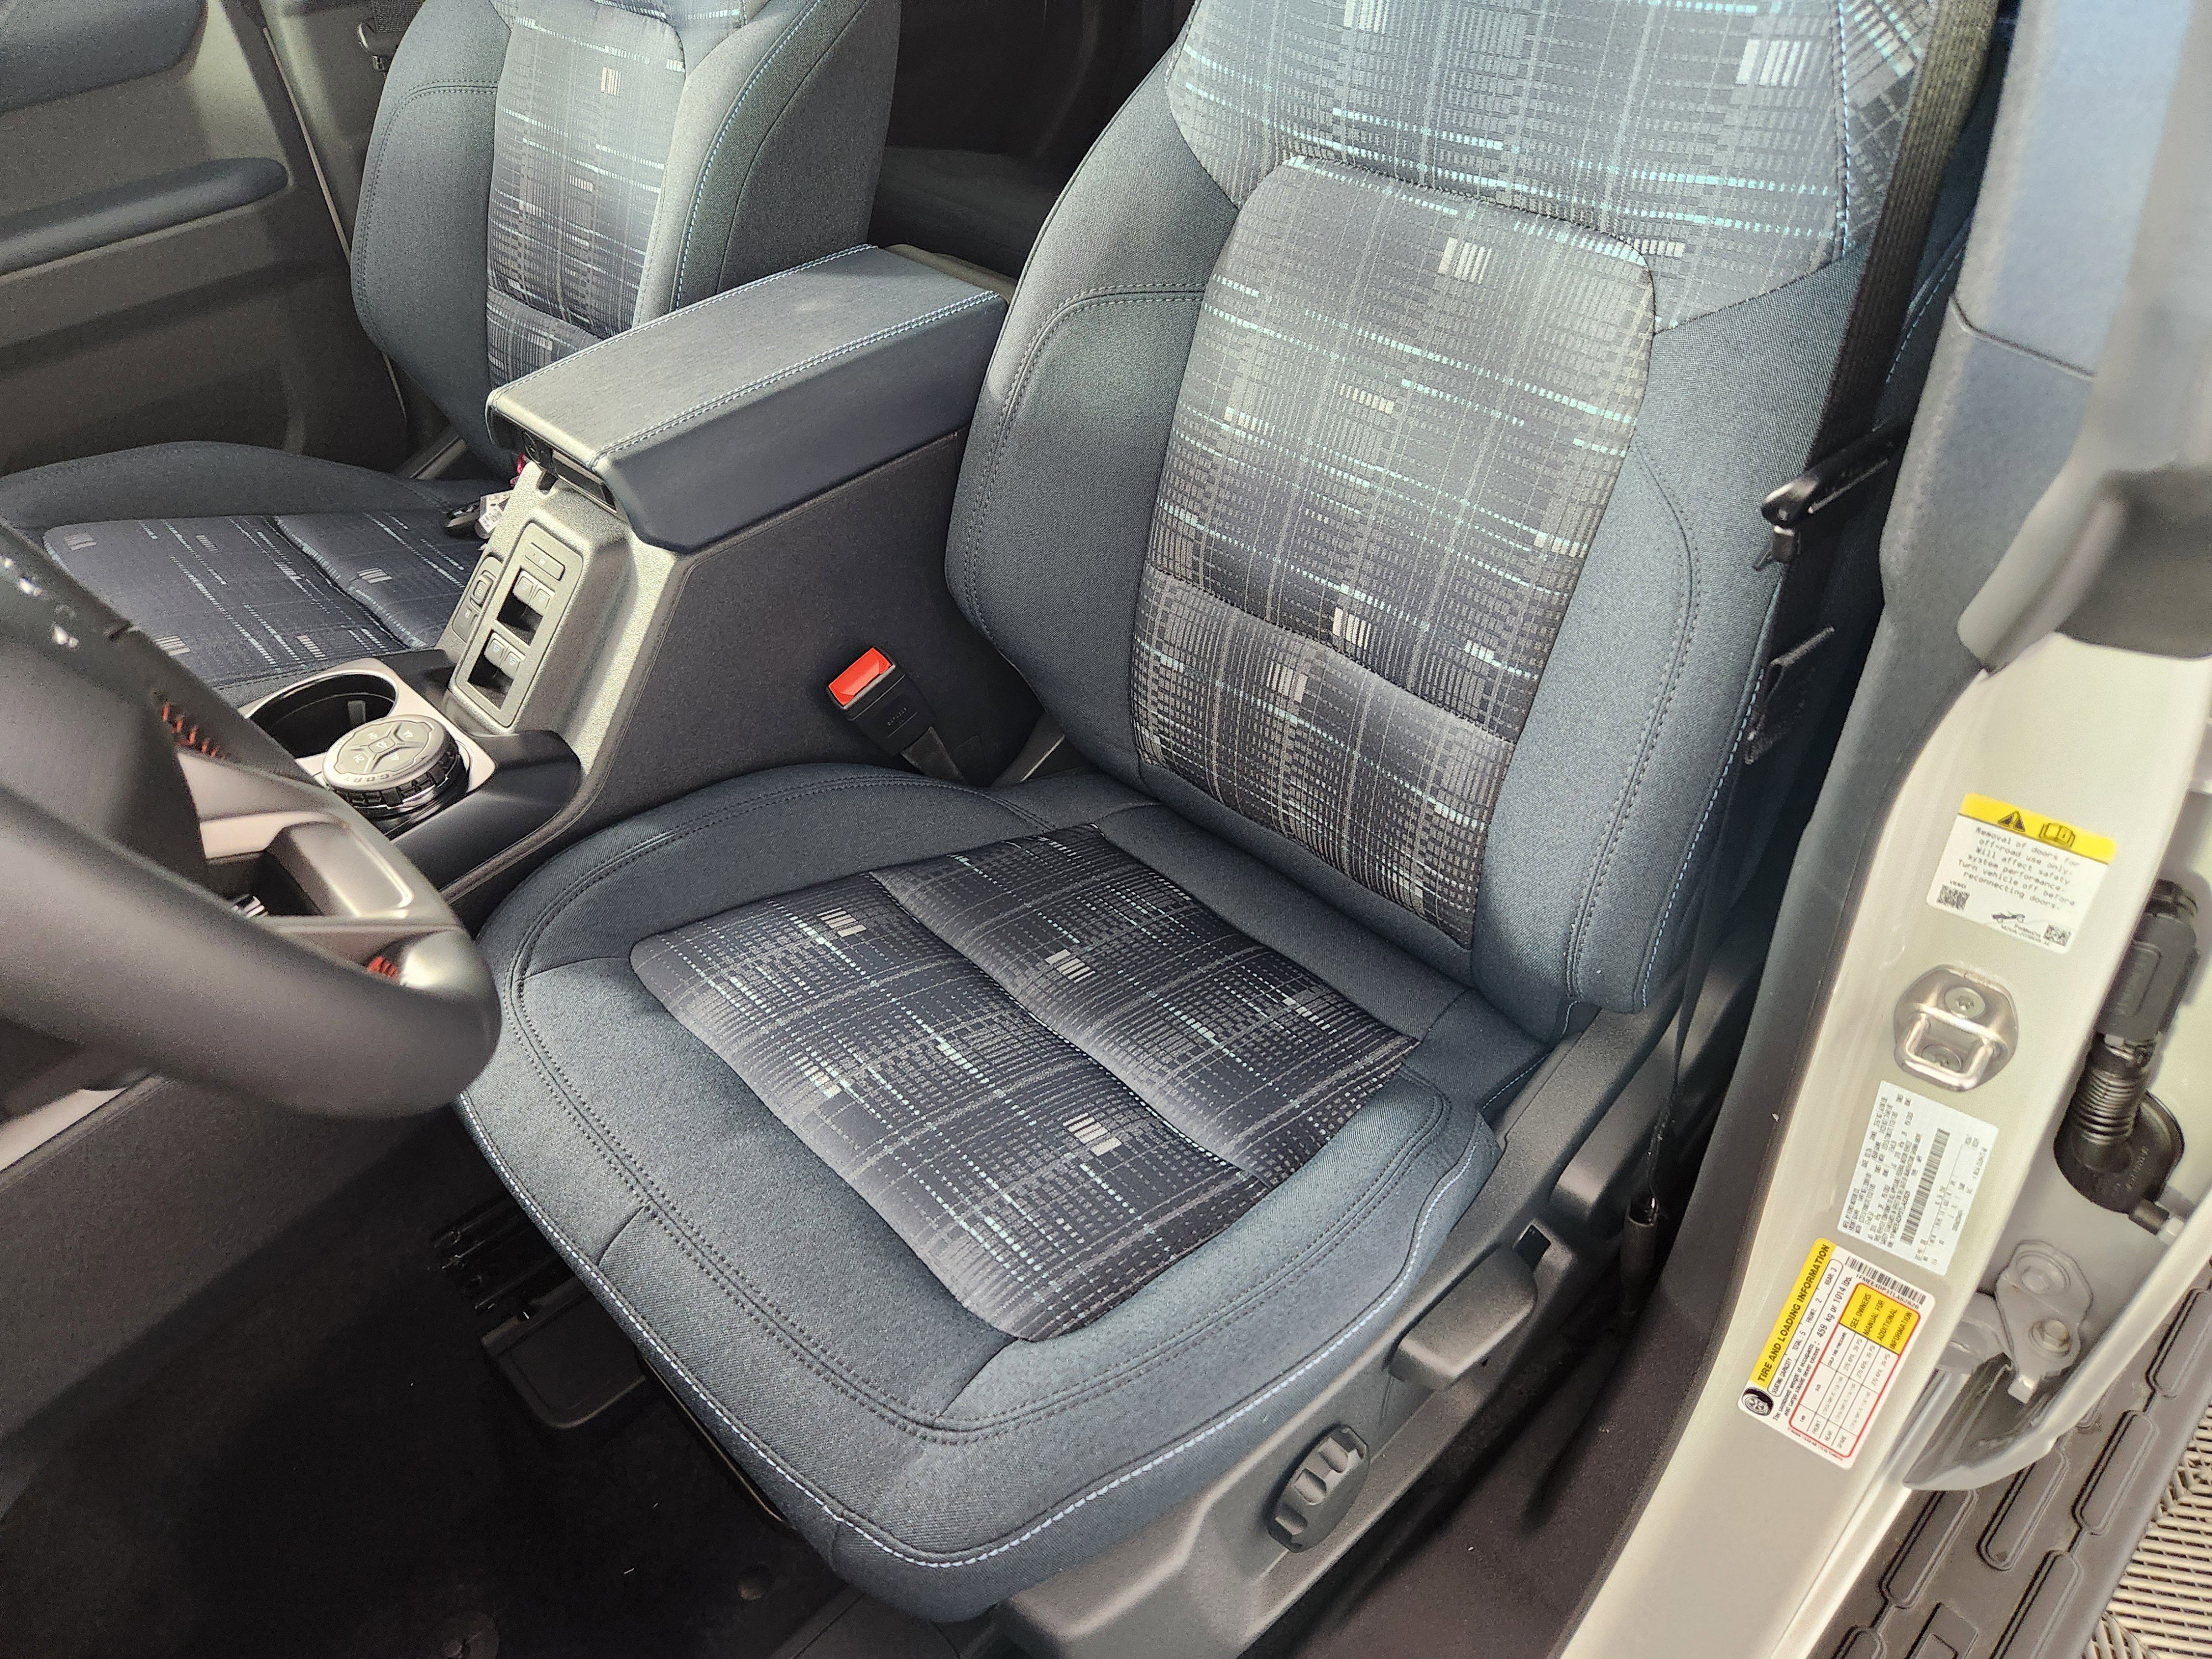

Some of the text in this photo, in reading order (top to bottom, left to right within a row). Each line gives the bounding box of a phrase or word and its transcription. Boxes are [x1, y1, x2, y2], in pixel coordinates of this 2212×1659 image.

[1975, 826, 2011, 844] Removal
[2031, 847, 2058, 860] doors
[2064, 857, 2080, 867] for
[1979, 839, 2072, 875] off-road use only.
[1959, 859, 1978, 872] Turn
[1983, 869, 2018, 886] vehicle
[2022, 883, 2038, 892] off
[2043, 890, 2075, 906] before
[1968, 854, 2063, 891] system performance.
[1975, 846, 2070, 885] Will affect safety
[1963, 872, 2025, 899] reconnecting
[2030, 895, 2059, 909] doors.
[1757, 1244, 1829, 1381] TIRE AND LOADING INFORMATION
[1817, 1273, 1853, 1338] 459 kg or 1014 lbs.
[1849, 1293, 1871, 1329] SEE OWNERS
[1863, 1299, 1885, 1335] MANUAL FOR
[1877, 1309, 1897, 1341] ADDITIONAL
[1889, 1312, 1912, 1349] INFORMATION
[1771, 1358, 1792, 1394] SEATING CAPACITY
[1772, 1412, 1781, 1421] The
[1778, 1389, 1792, 1412] combined
[1790, 1373, 1799, 1389] weight
[1800, 1344, 1814, 1367] occupants
[1788, 1394, 1797, 1407] cargo
[1795, 1377, 1805, 1393] should
[1803, 1364, 1812, 1377] never
[1809, 1347, 1820, 1364] exceed
[1812, 1420, 1821, 1434] FRONT
[1824, 1430, 1832, 1441] REAR
[1837, 1434, 1846, 1448] SPARE
